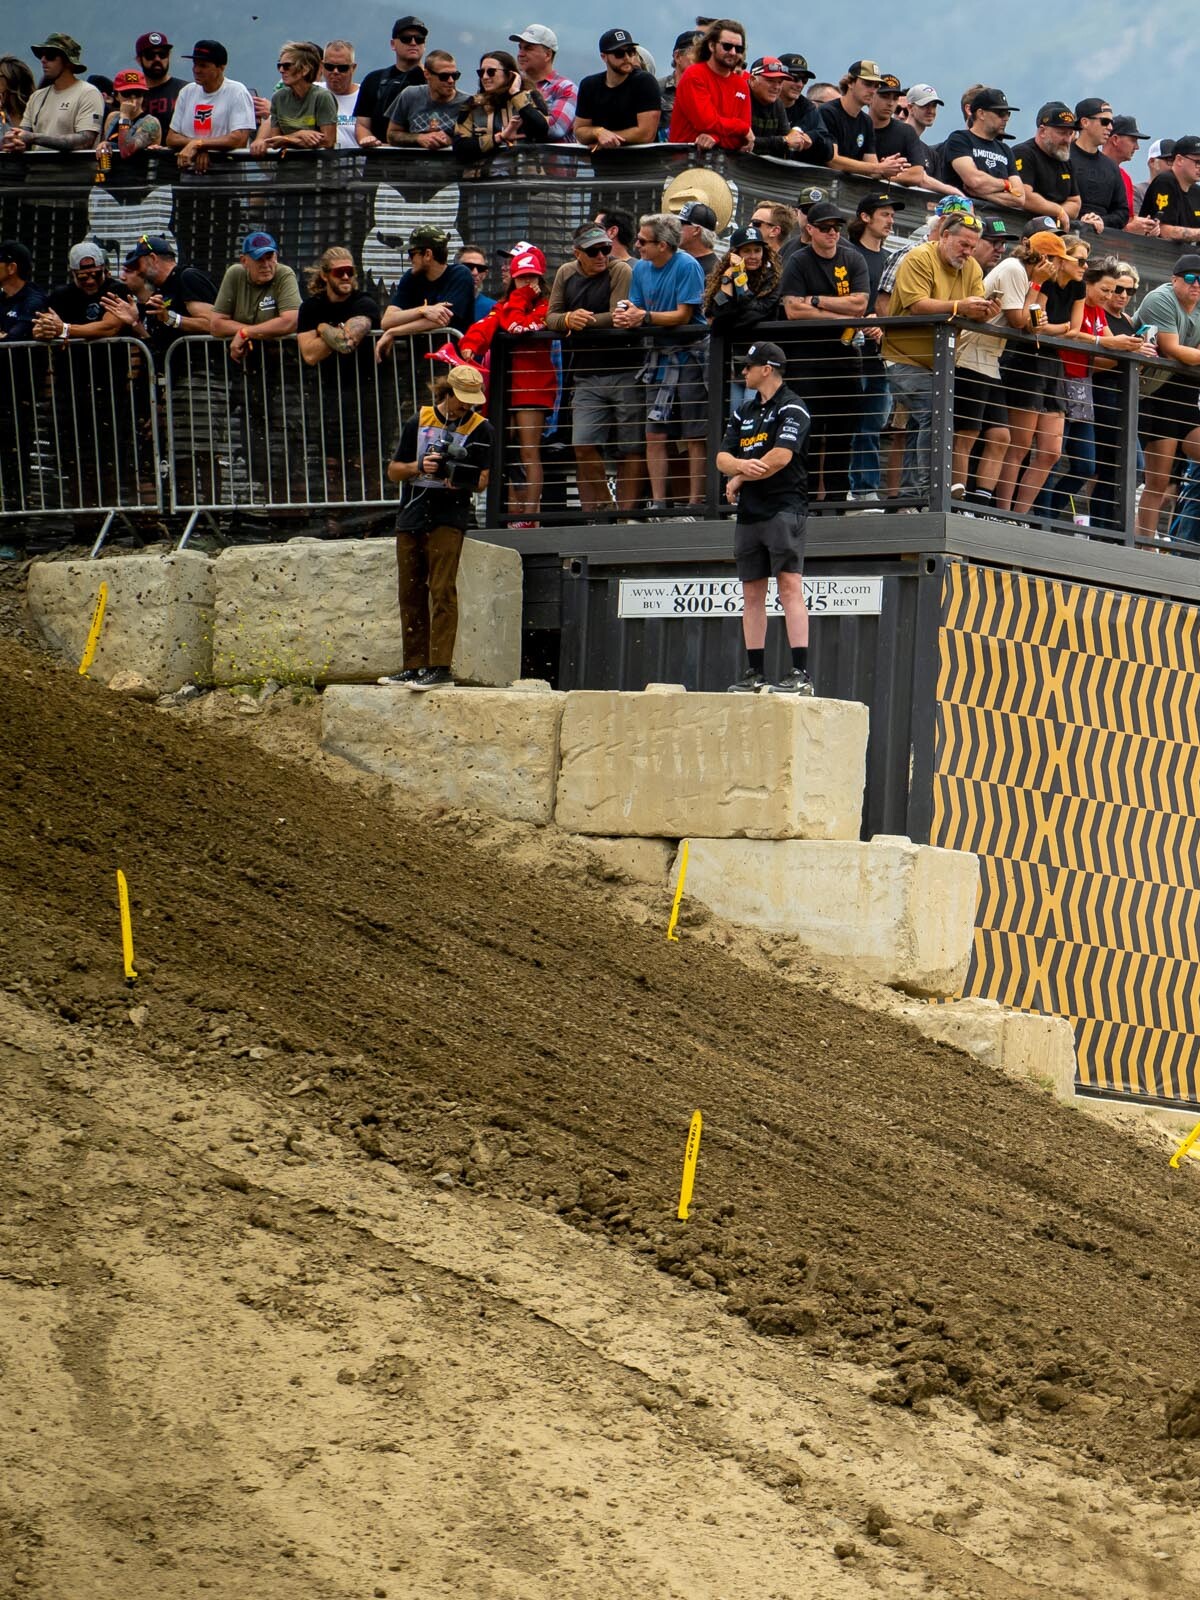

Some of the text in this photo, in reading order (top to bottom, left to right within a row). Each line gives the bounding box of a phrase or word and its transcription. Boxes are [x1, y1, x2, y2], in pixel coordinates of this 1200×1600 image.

[643, 595, 860, 613] BUY 800-62-845 RENT
